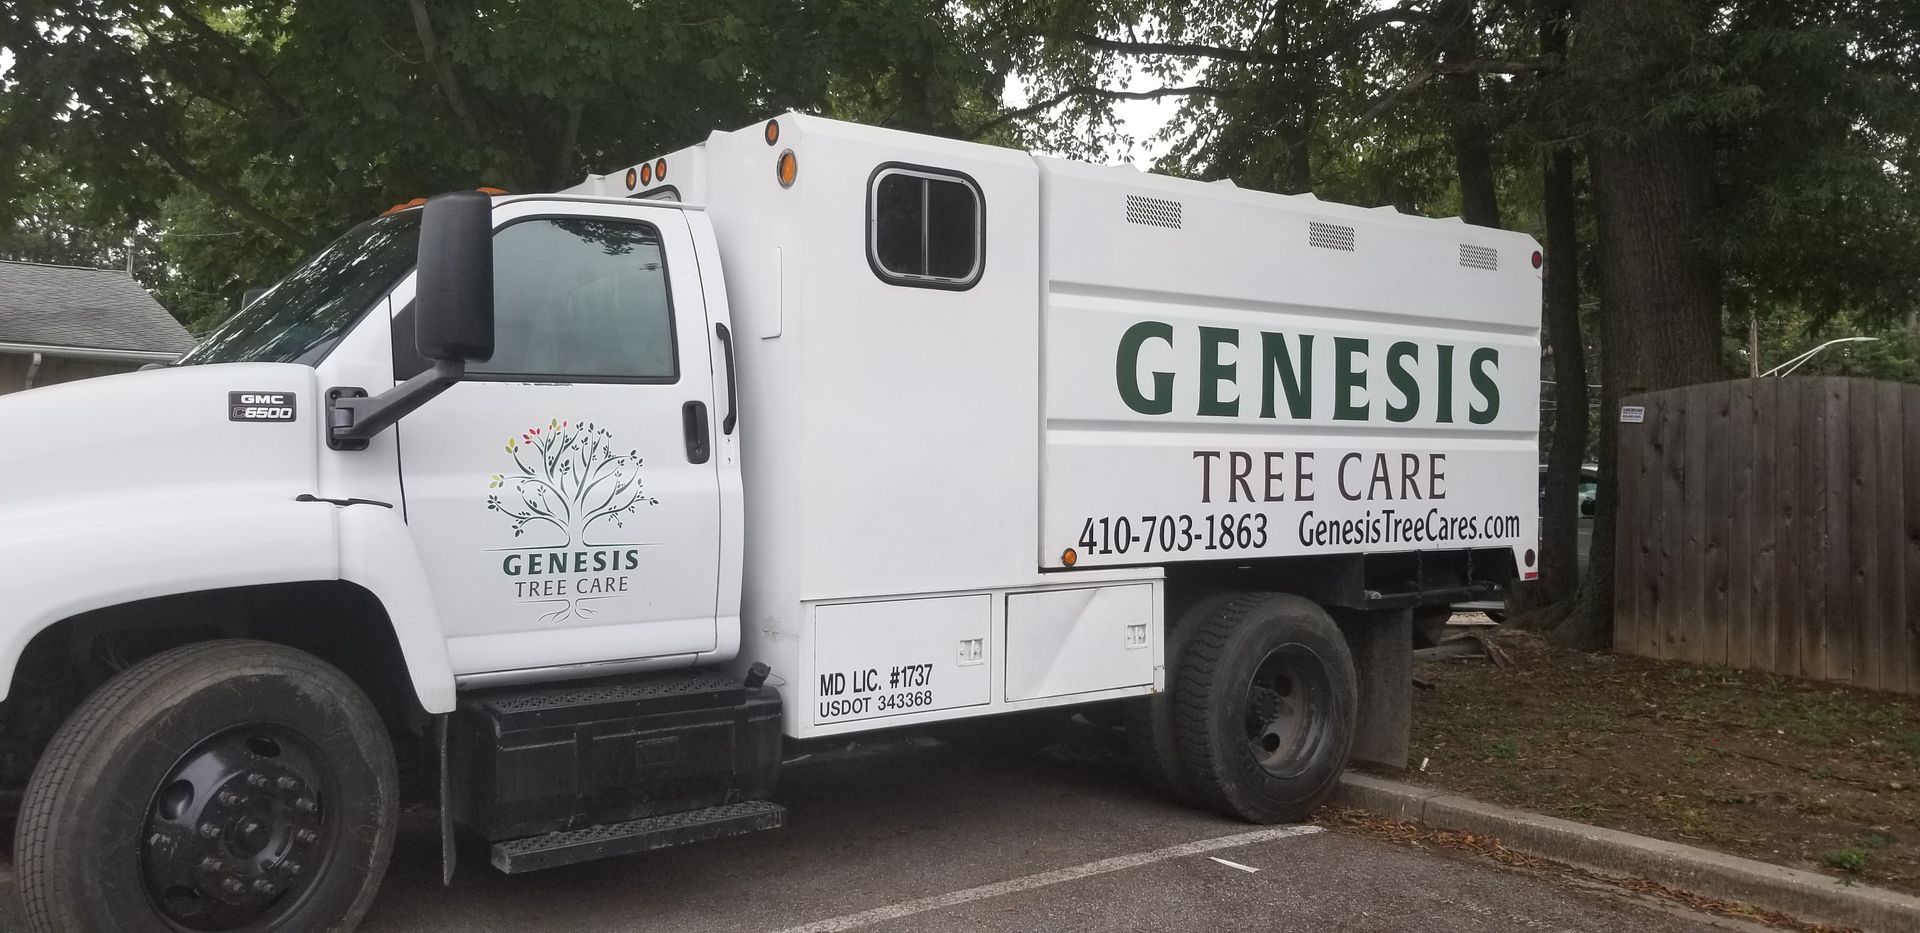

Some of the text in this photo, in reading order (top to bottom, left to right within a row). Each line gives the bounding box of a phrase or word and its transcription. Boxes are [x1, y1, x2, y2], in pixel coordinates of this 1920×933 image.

[1116, 321, 1500, 425] GENESIS
[233, 407, 293, 419] C6500
[241, 394, 284, 404] GMC
[1193, 450, 1447, 503] TREE CARE
[1078, 508, 1520, 555] 410-703-1863 GenesisTreeCares.com
[502, 550, 639, 576] GENESIS
[514, 576, 629, 598] TREE CARE
[820, 663, 933, 696] MD LIC. #1737
[820, 690, 932, 718] USDOT 343368
